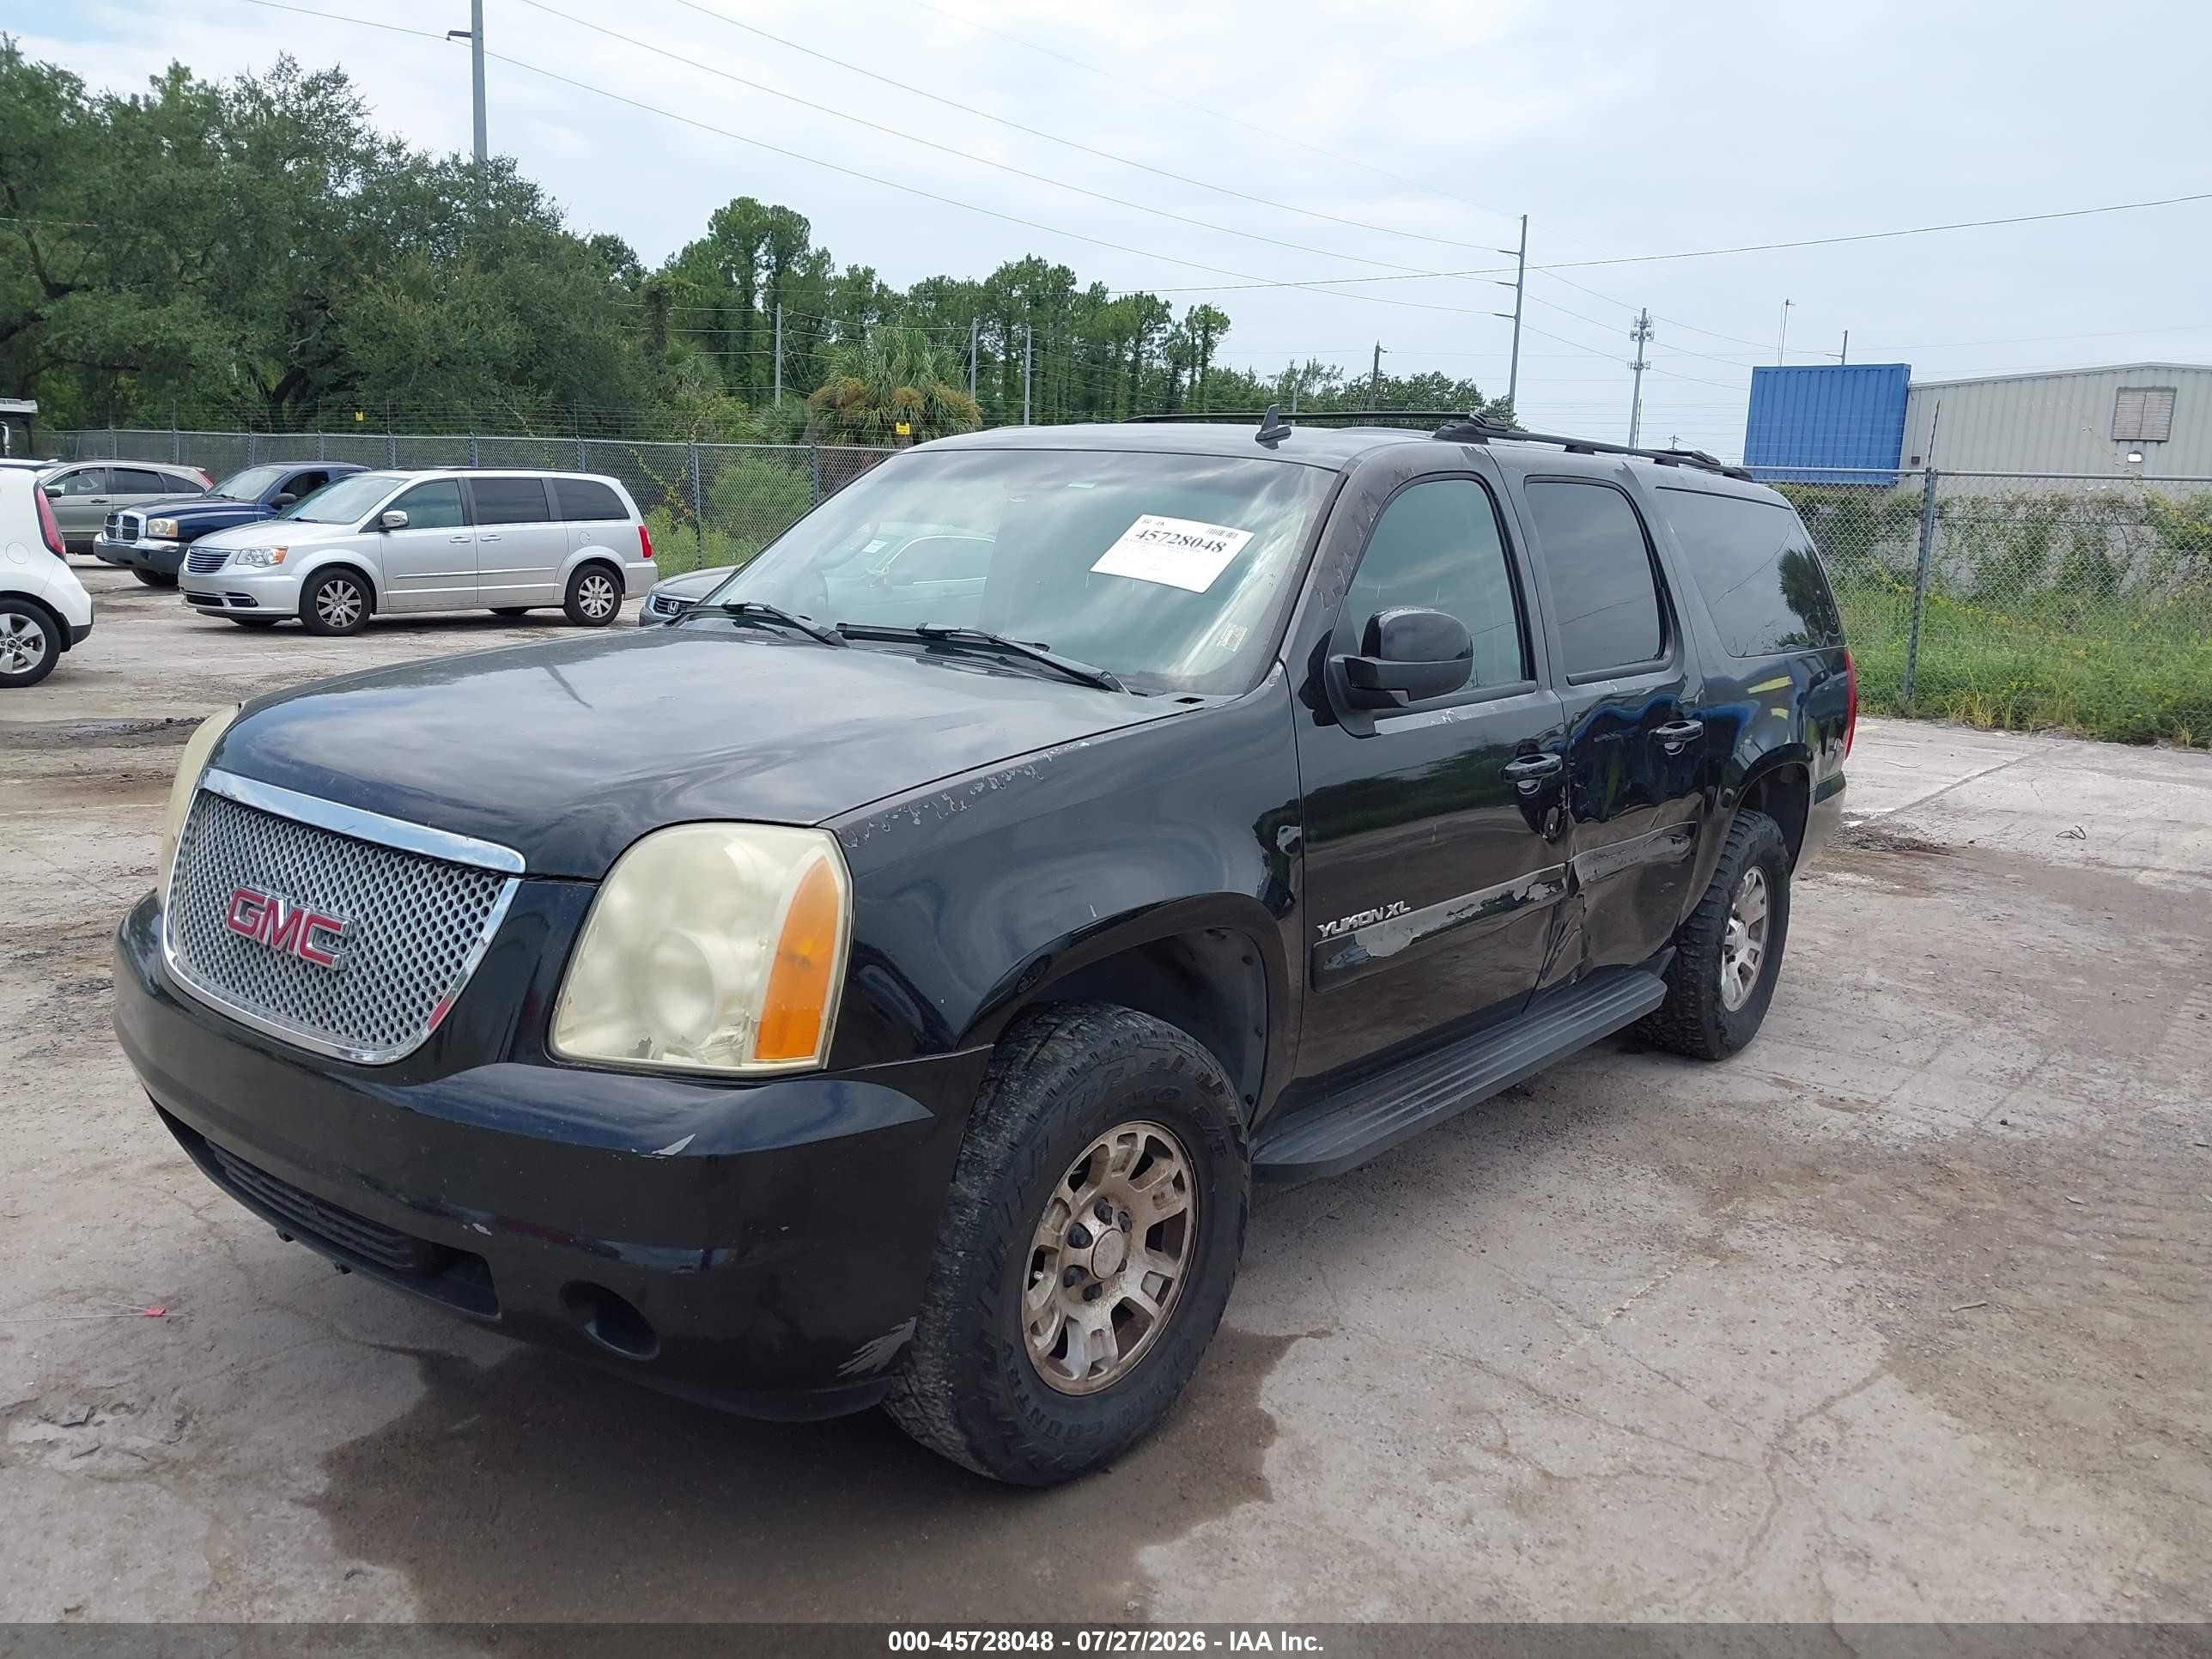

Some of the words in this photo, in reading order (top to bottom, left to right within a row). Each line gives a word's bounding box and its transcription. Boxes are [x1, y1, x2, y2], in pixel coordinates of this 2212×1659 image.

[1135, 529, 1227, 553] 45728048
[226, 885, 350, 971] GMC
[1316, 907, 1384, 939] YUKON
[1384, 900, 1411, 918] XL
